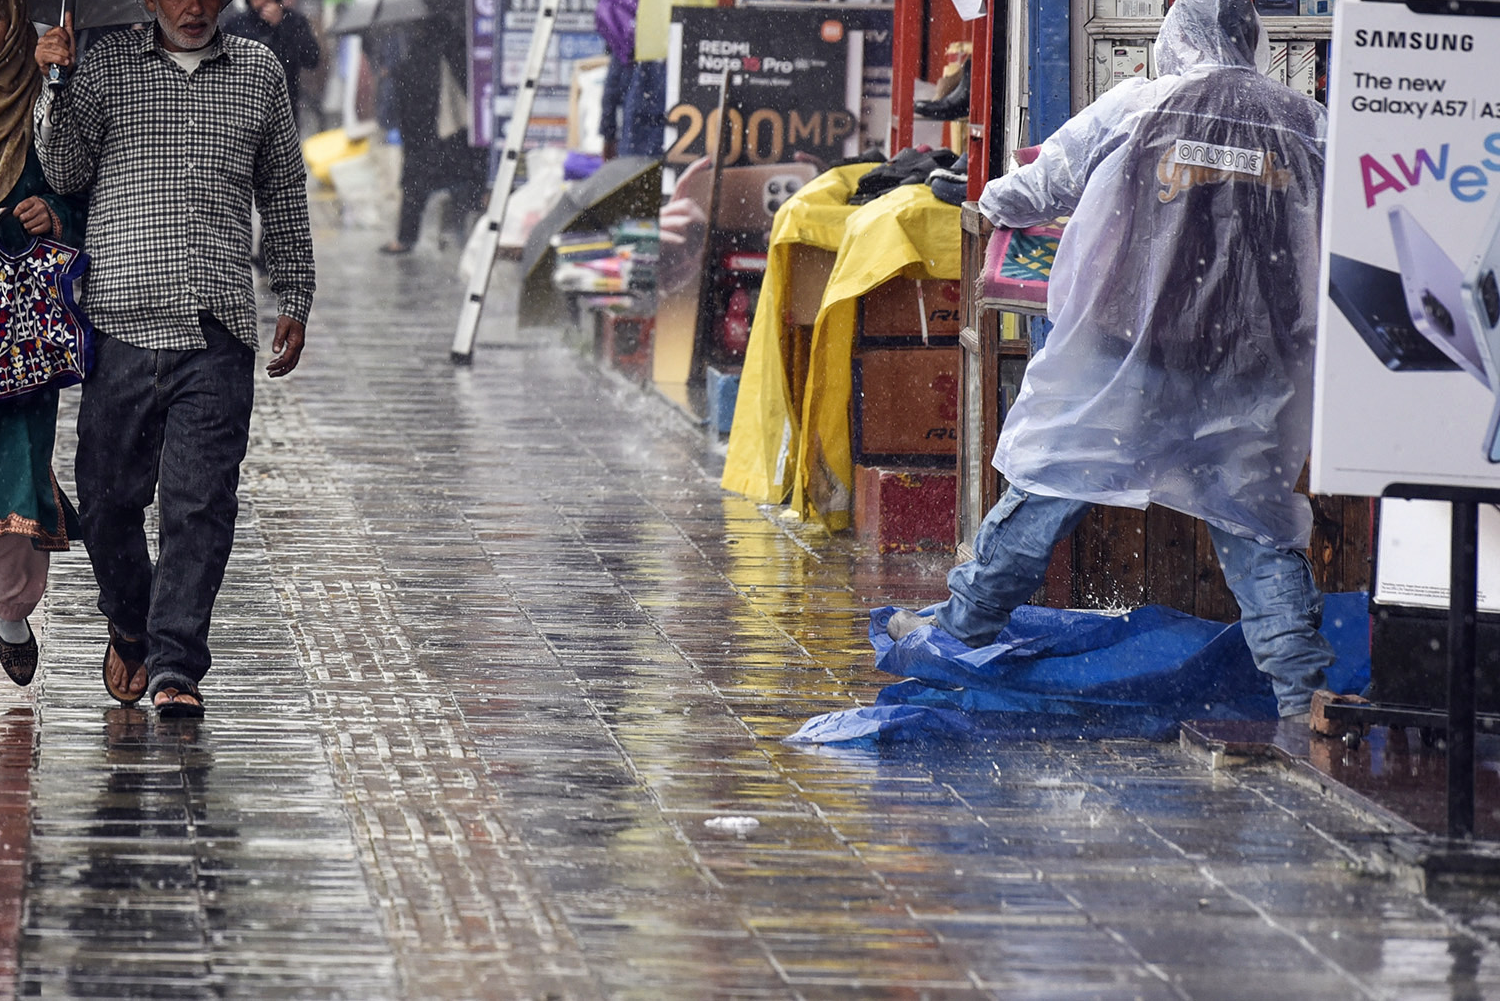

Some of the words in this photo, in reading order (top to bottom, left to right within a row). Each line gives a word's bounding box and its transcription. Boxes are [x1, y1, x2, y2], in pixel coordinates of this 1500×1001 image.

[699, 40, 750, 56] REDMI
[1355, 29, 1474, 52] SAMSUNG
[762, 58, 794, 74] Pro
[1353, 72, 1392, 89] The
[1398, 77, 1446, 93] new
[1351, 96, 1428, 119] Galaxy
[1430, 100, 1468, 117] A57
